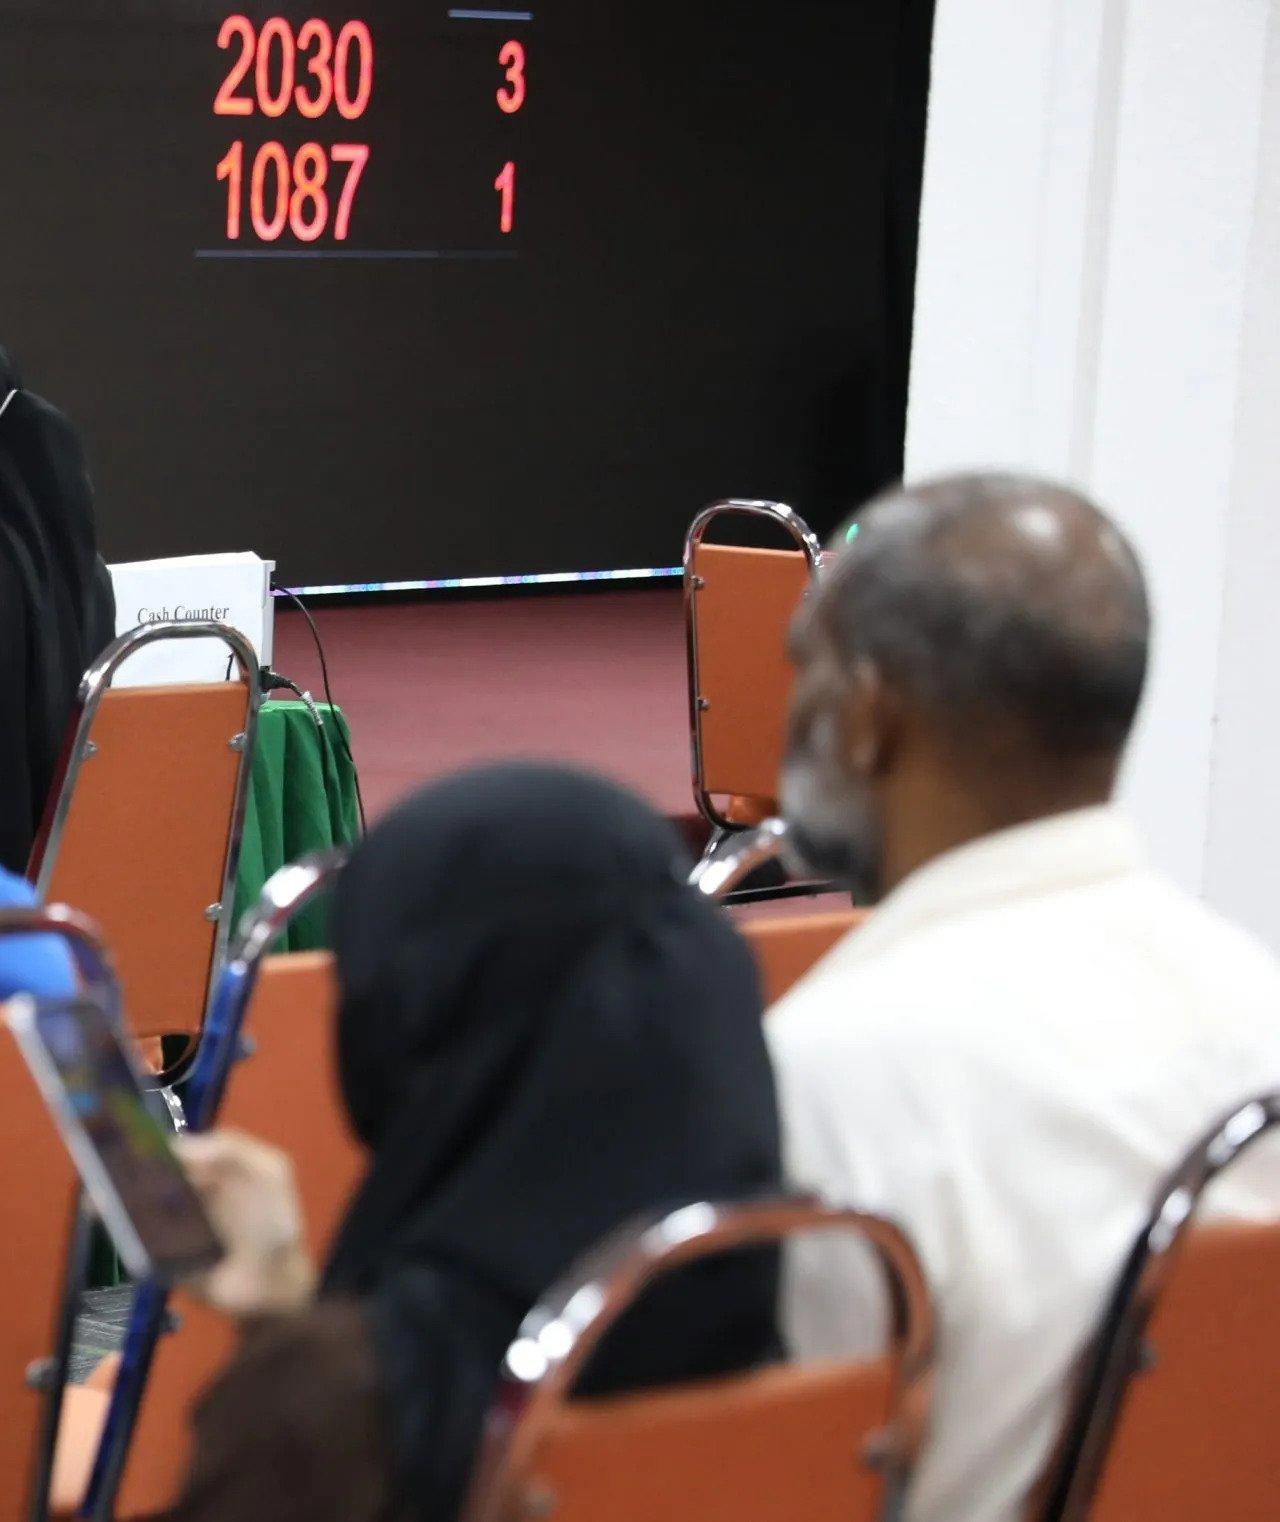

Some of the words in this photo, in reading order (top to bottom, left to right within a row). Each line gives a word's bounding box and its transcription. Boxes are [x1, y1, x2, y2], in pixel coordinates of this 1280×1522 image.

[212, 13, 374, 120] 2030
[495, 39, 526, 114] 3
[215, 140, 370, 242] 1087
[494, 161, 516, 234] 1
[137, 606, 170, 624] Cash
[173, 605, 230, 622] Counter
